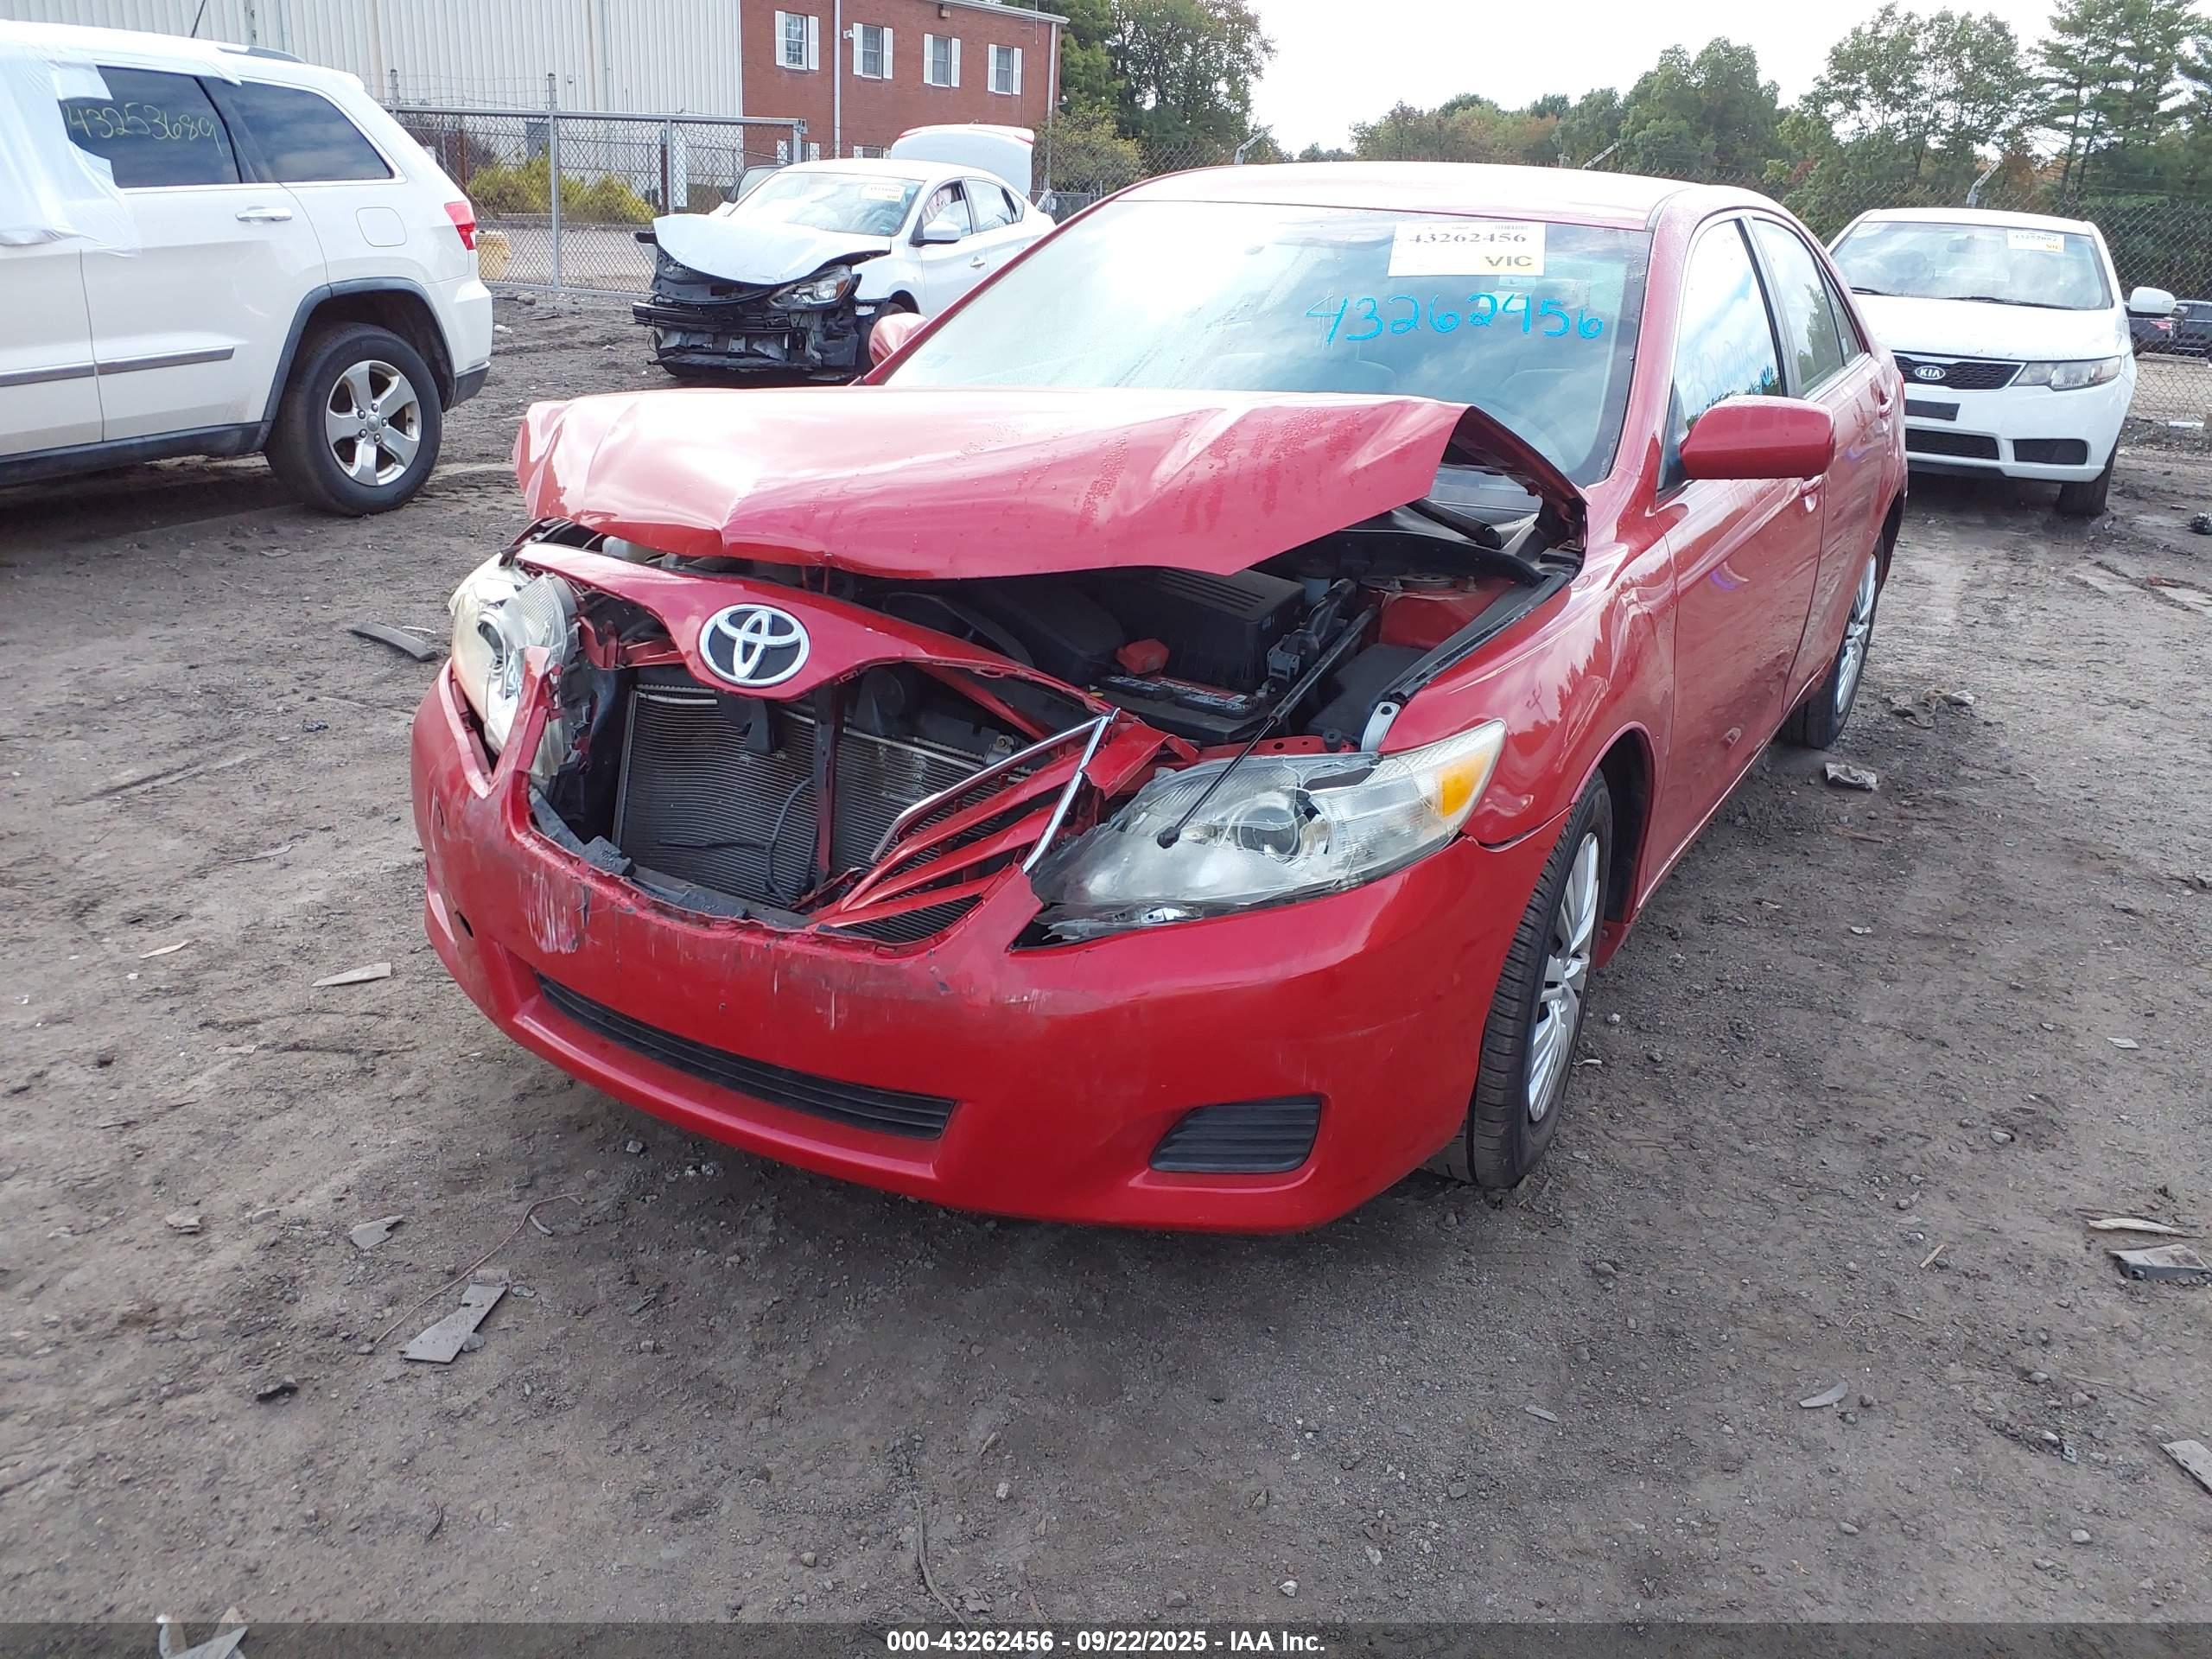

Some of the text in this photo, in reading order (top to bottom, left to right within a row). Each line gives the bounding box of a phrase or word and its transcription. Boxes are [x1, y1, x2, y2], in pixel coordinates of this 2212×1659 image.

[65, 102, 223, 156] 43253689
[1409, 232, 1527, 243] 43262456
[1484, 255, 1533, 267] VIC
[1306, 293, 1604, 346] 43262456
[1919, 368, 1941, 378] KIA
